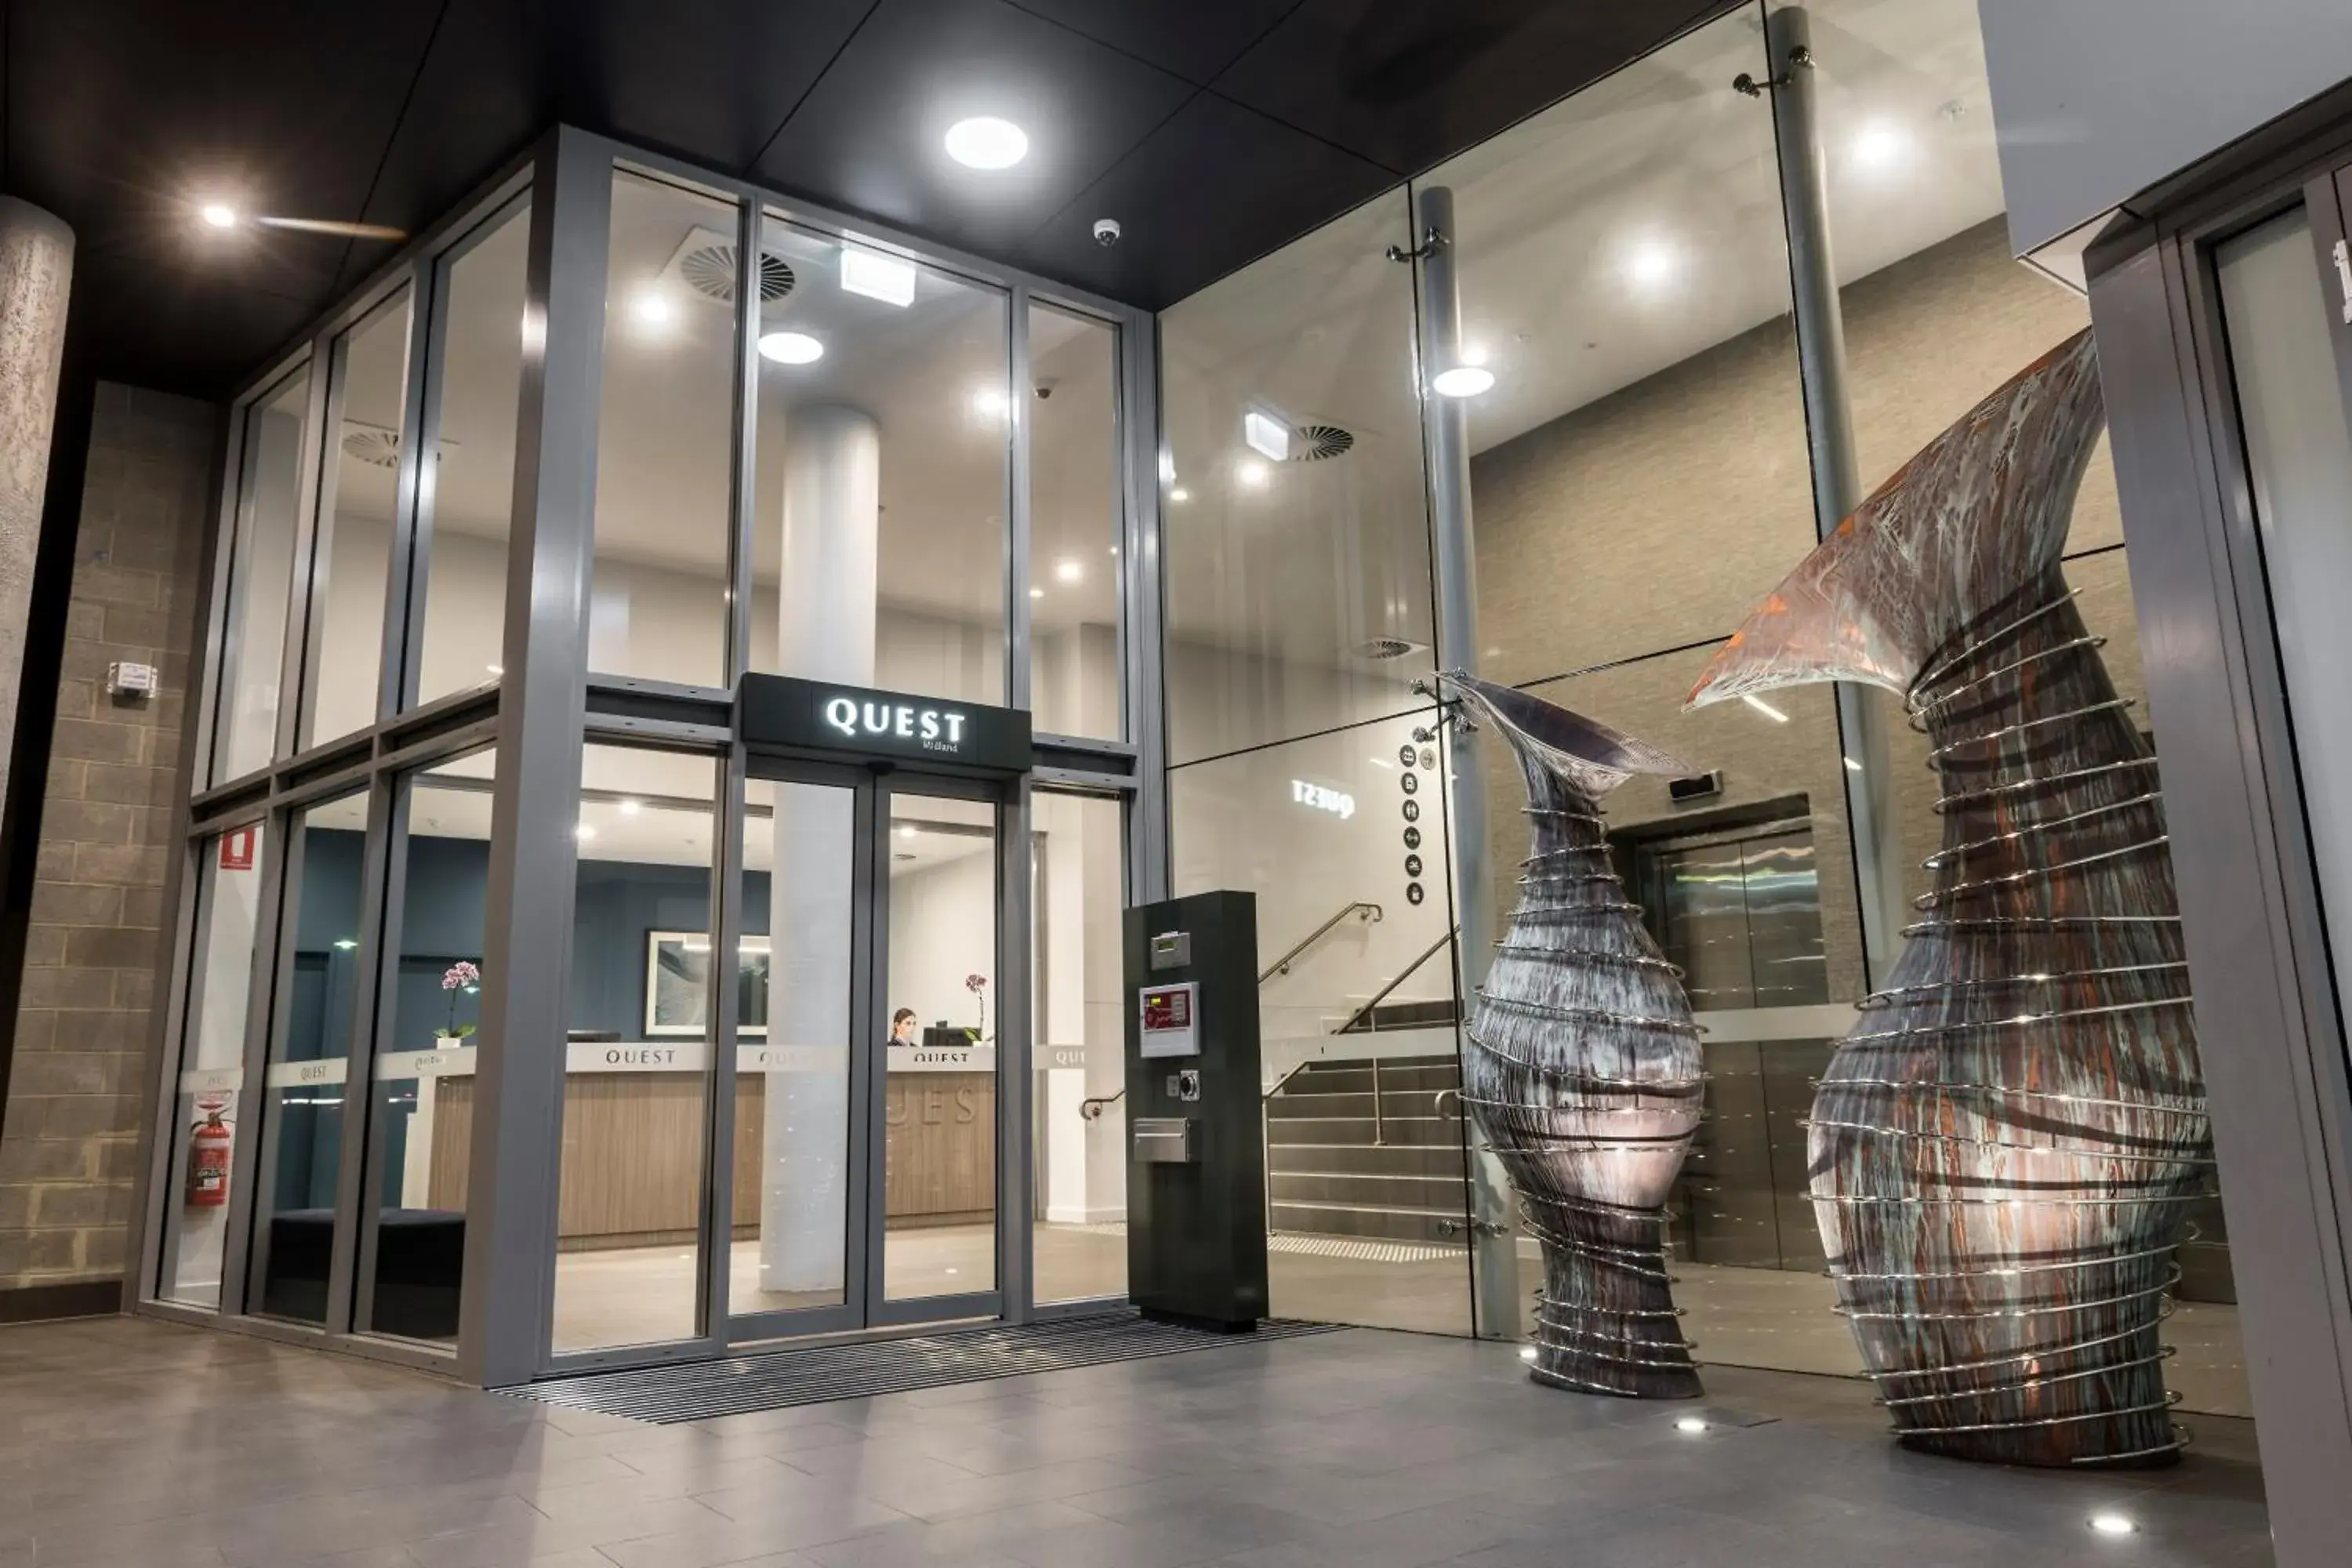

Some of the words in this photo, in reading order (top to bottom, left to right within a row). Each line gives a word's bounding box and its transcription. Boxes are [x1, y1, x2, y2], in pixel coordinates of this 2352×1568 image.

[826, 698, 965, 742] QUEST
[606, 1050, 676, 1064] QUEST
[301, 1065, 327, 1081] QUEST
